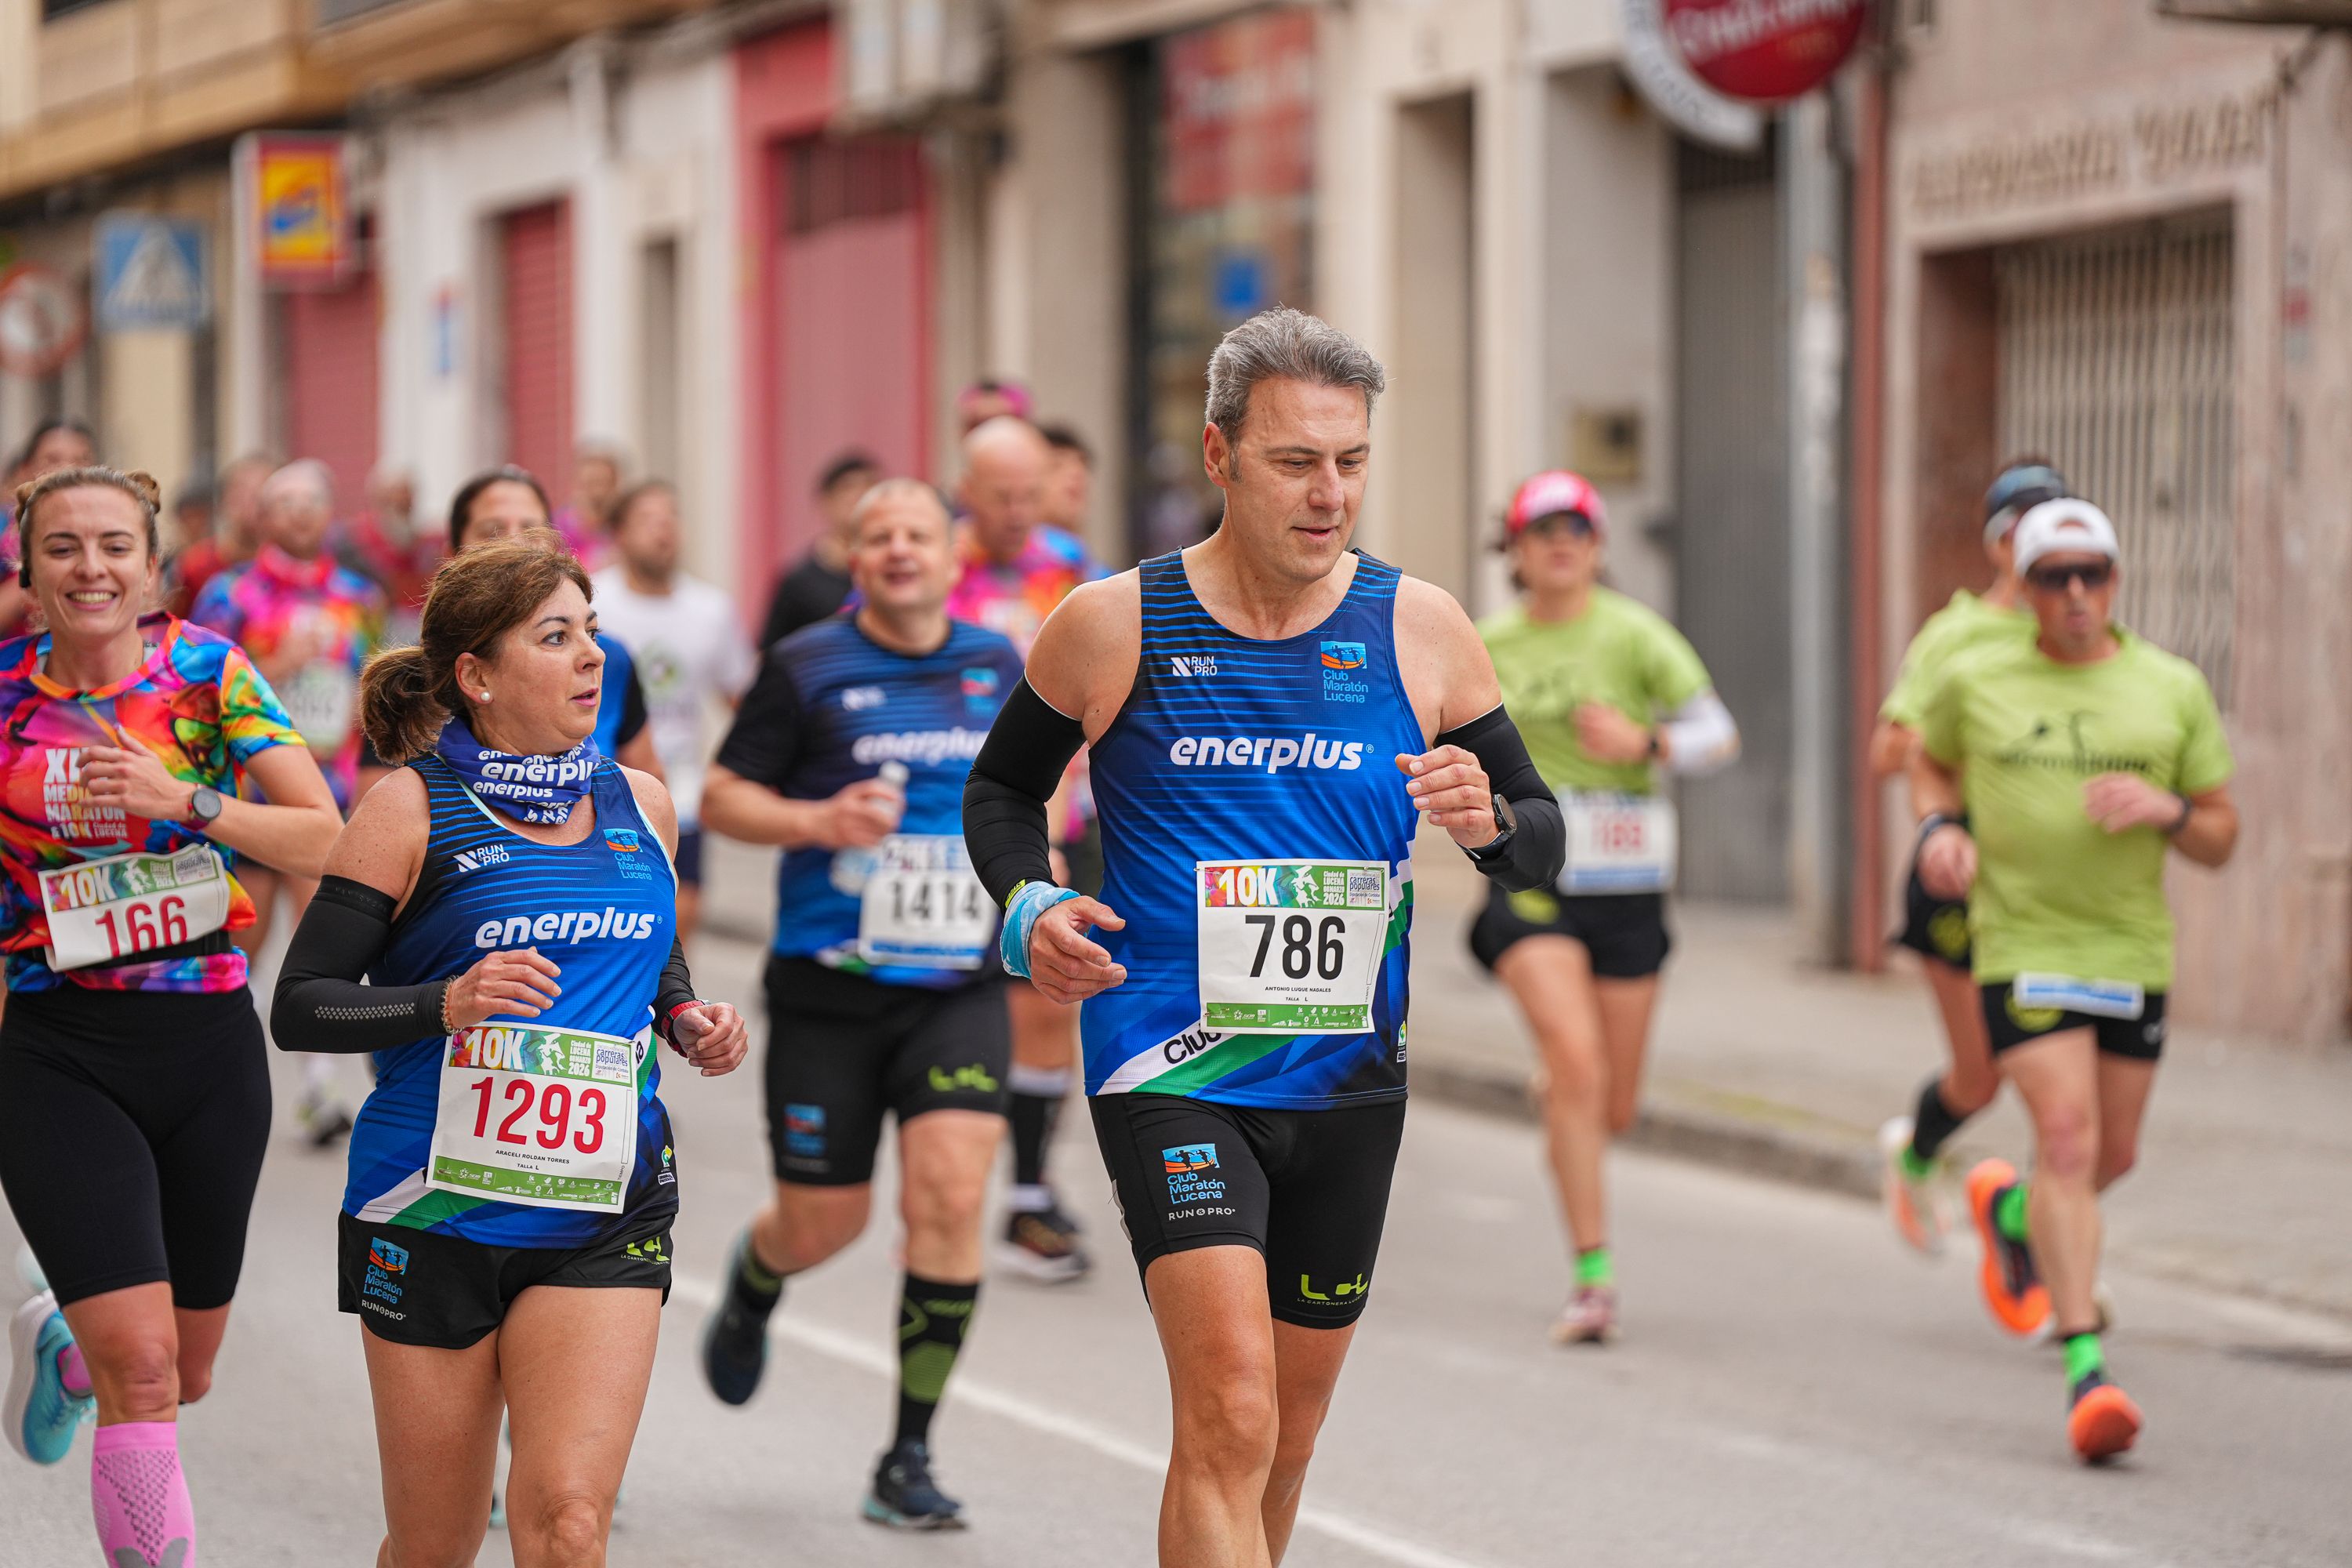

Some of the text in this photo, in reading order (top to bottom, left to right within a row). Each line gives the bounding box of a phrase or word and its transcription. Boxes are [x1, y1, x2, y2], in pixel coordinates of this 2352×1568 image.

[1191, 655, 1214, 666] RUN
[1194, 666, 1218, 677] PRO
[1323, 669, 1348, 681] Club
[1323, 680, 1369, 693] Maratón
[1323, 691, 1366, 703] Lucena
[473, 782, 554, 799] enerplus
[477, 844, 504, 858] RUN
[614, 852, 635, 862] Club
[483, 852, 510, 866] PRO
[617, 861, 652, 872] Maratón
[620, 870, 652, 880] Lucena
[1323, 877, 1345, 886] LUCENA
[1350, 877, 1376, 885] carreras
[60, 865, 117, 908] 10K
[1219, 868, 1278, 906] 10K
[1349, 883, 1380, 892] populares
[891, 880, 979, 922] 1414
[1323, 892, 1345, 906] 2026
[95, 895, 187, 958] 166
[1245, 915, 1345, 980] 786
[465, 1029, 525, 1069] 10K
[570, 1046, 590, 1056] LUCENA
[597, 1048, 624, 1059] carreras
[596, 1054, 628, 1067] populares
[568, 1062, 590, 1077] 2026
[471, 1076, 606, 1154] 1293
[495, 1149, 521, 1158] ARACELI
[1167, 1172, 1198, 1185] Club
[1169, 1179, 1225, 1195] Maratón
[1171, 1191, 1222, 1204] Lucena
[367, 1265, 388, 1279] Club
[365, 1274, 402, 1296] Maratón
[363, 1283, 397, 1304] Lucena
